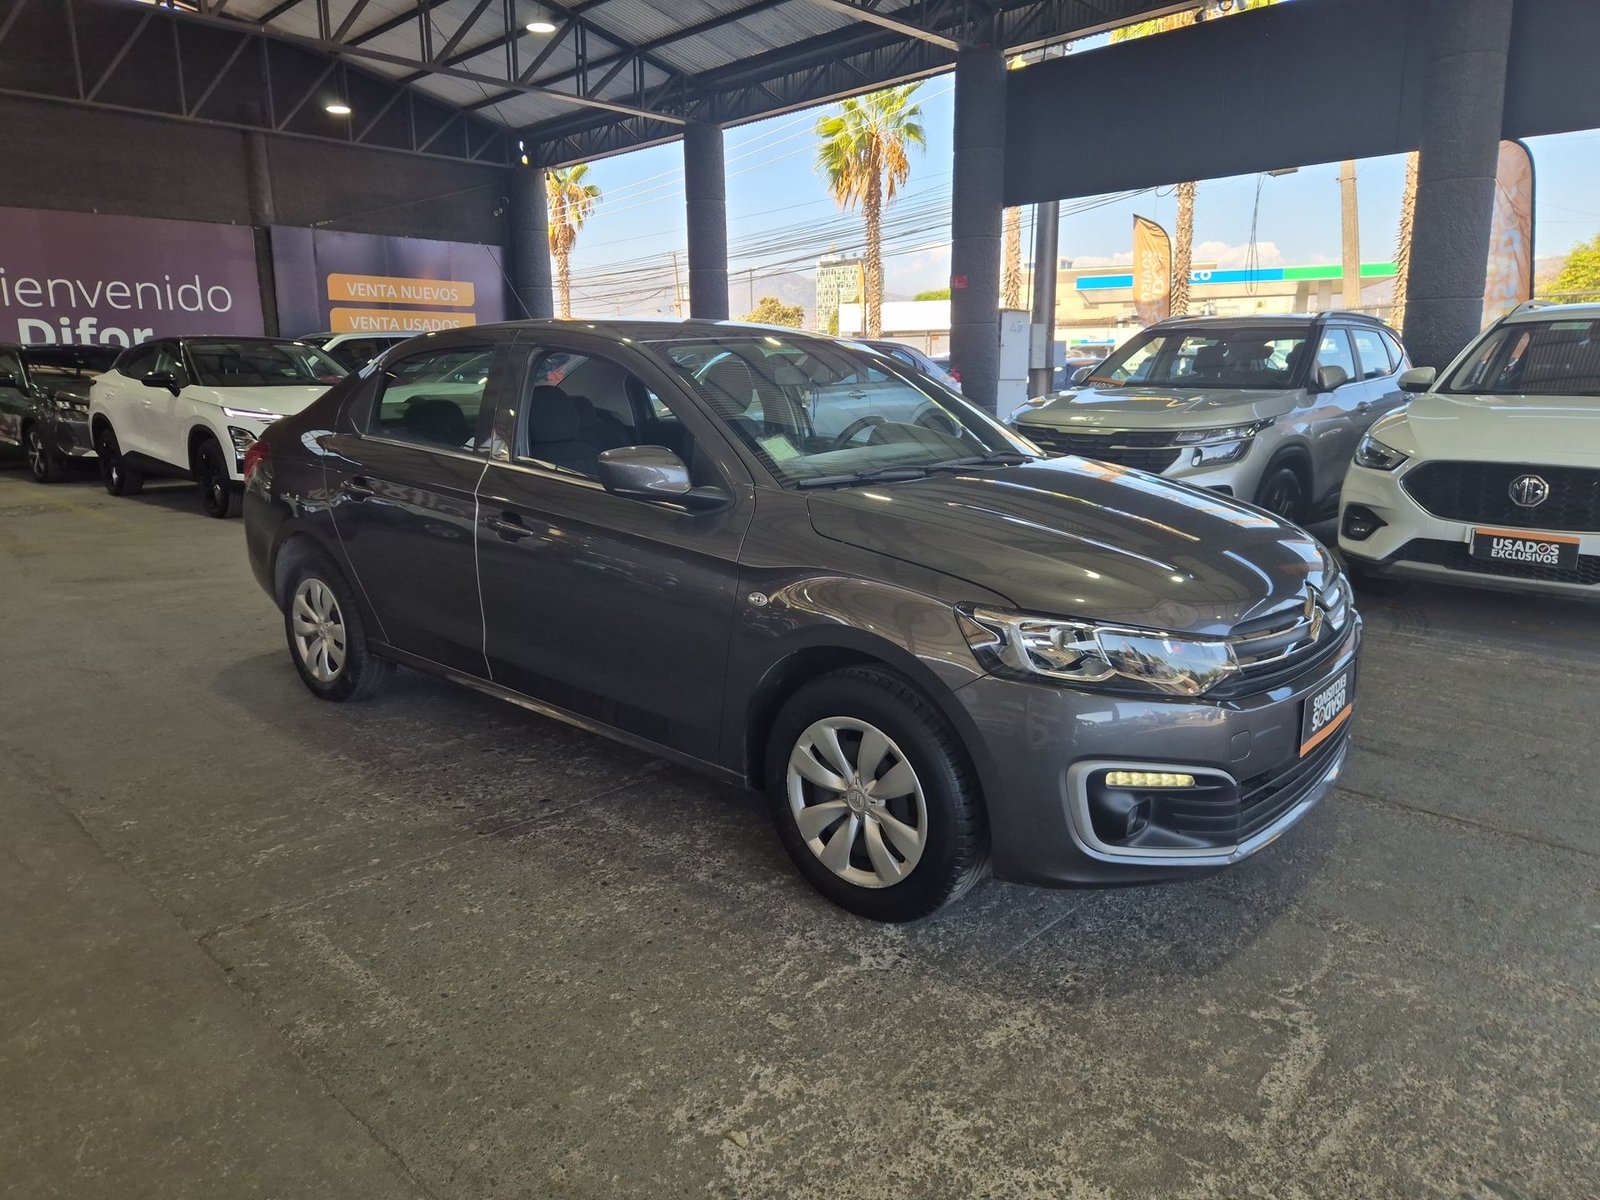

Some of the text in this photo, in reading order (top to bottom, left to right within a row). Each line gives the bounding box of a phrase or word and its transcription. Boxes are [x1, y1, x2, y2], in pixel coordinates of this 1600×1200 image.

[0, 268, 232, 312] ienvenido
[346, 282, 458, 301] VENTA NUEVOS
[349, 316, 460, 332] VENTA USADOS
[1512, 478, 1544, 504] MG
[1491, 548, 1559, 564] EXCLUSIVOS
[1492, 537, 1560, 556] USADOS
[1312, 689, 1346, 731] USADOS
